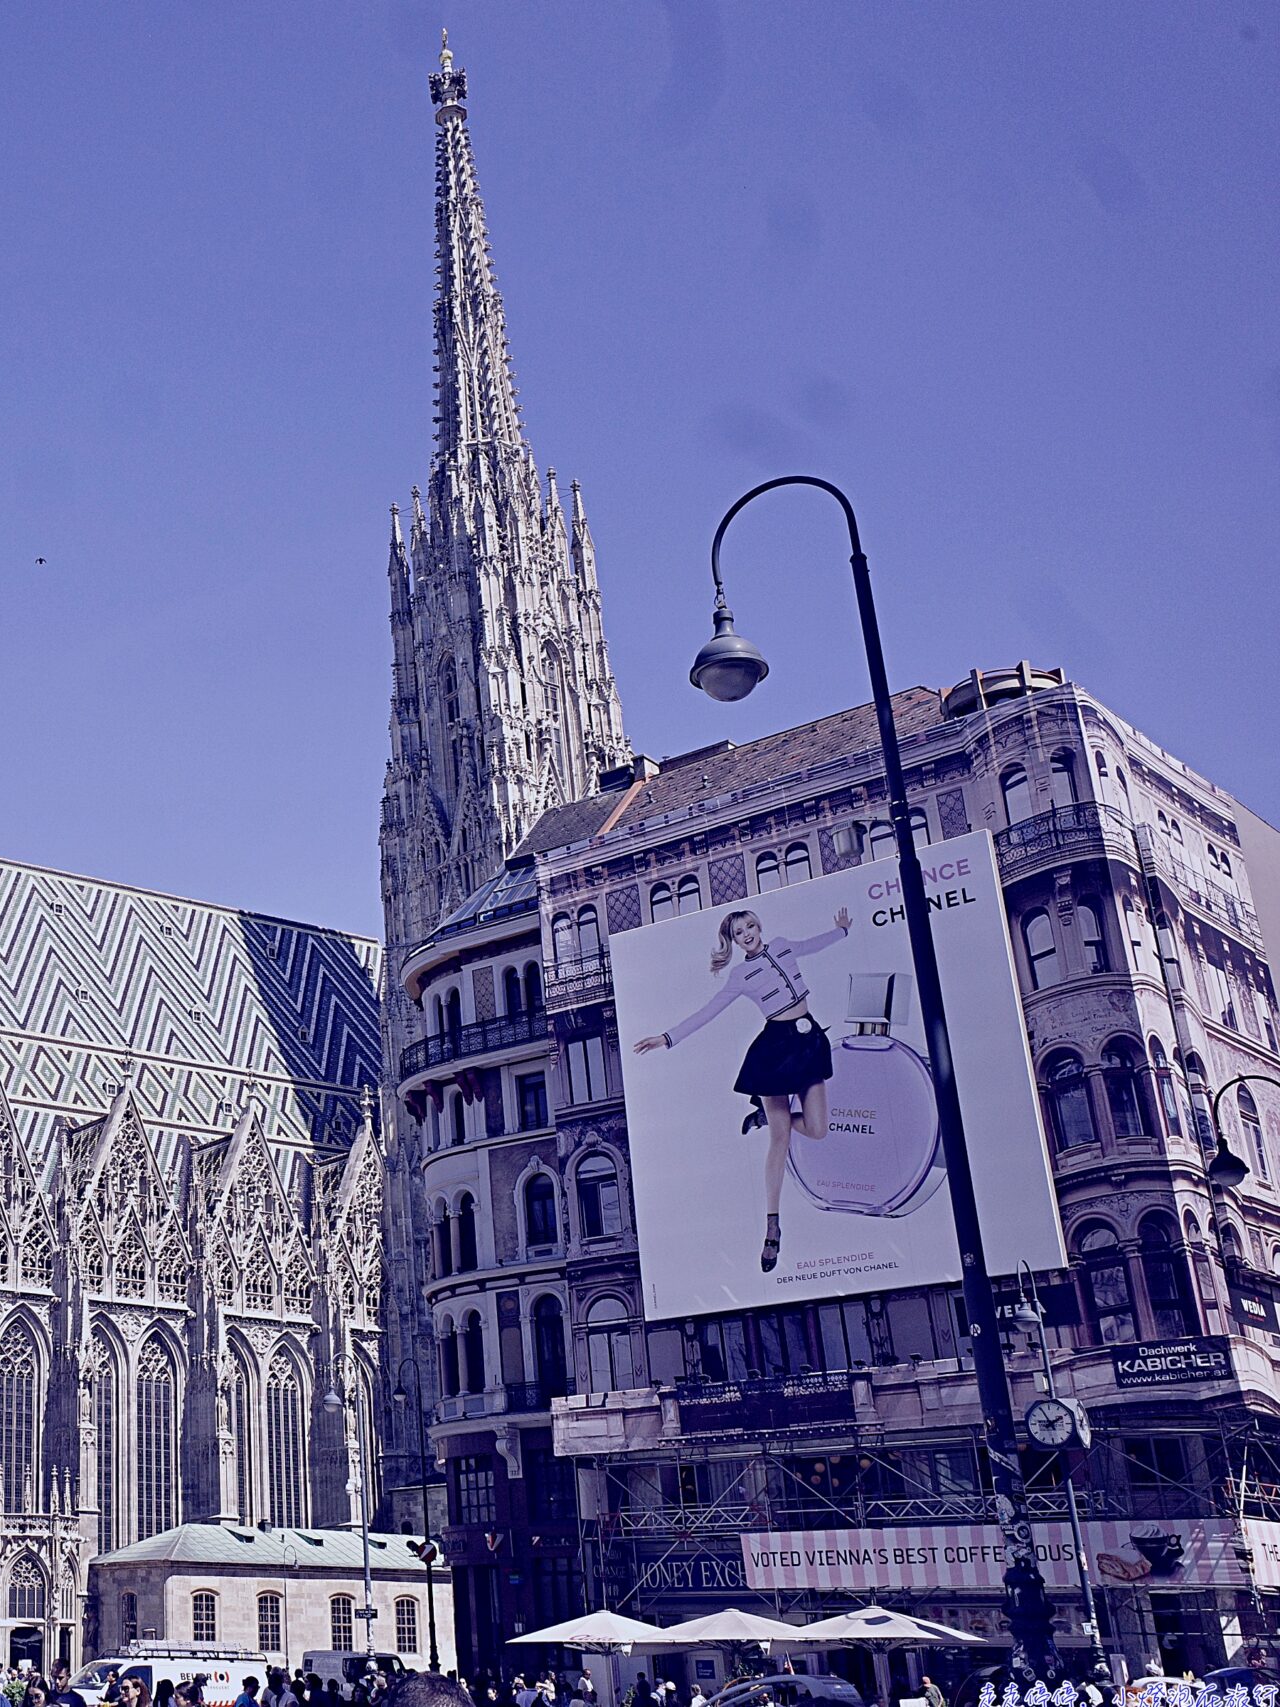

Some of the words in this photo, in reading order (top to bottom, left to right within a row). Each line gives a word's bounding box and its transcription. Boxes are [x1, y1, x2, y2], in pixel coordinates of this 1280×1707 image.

[867, 858, 971, 900] CHNCE
[872, 887, 976, 927] CHNEL
[830, 1108, 877, 1120] CHANCE
[828, 1122, 875, 1135] CHANEL
[831, 1181, 877, 1192] SPLENDIDE
[796, 1260, 816, 1270] EAU
[818, 1251, 874, 1267] SPLENDIDE
[776, 1276, 794, 1284] DER
[795, 1272, 818, 1282] NEUE
[819, 1269, 842, 1279] DUFT
[843, 1266, 862, 1275] VON
[863, 1261, 899, 1273] CHANEL
[1138, 1342, 1197, 1357] Dachwerk
[1117, 1352, 1226, 1374] KABICHER
[1121, 1368, 1228, 1384] www.kabicher.at
[751, 1551, 801, 1568] VOTED
[893, 1547, 939, 1565] BEST
[944, 1545, 1005, 1564] COFFE
[1034, 1543, 1083, 1562] OUS
[631, 1560, 695, 1588] MONEY
